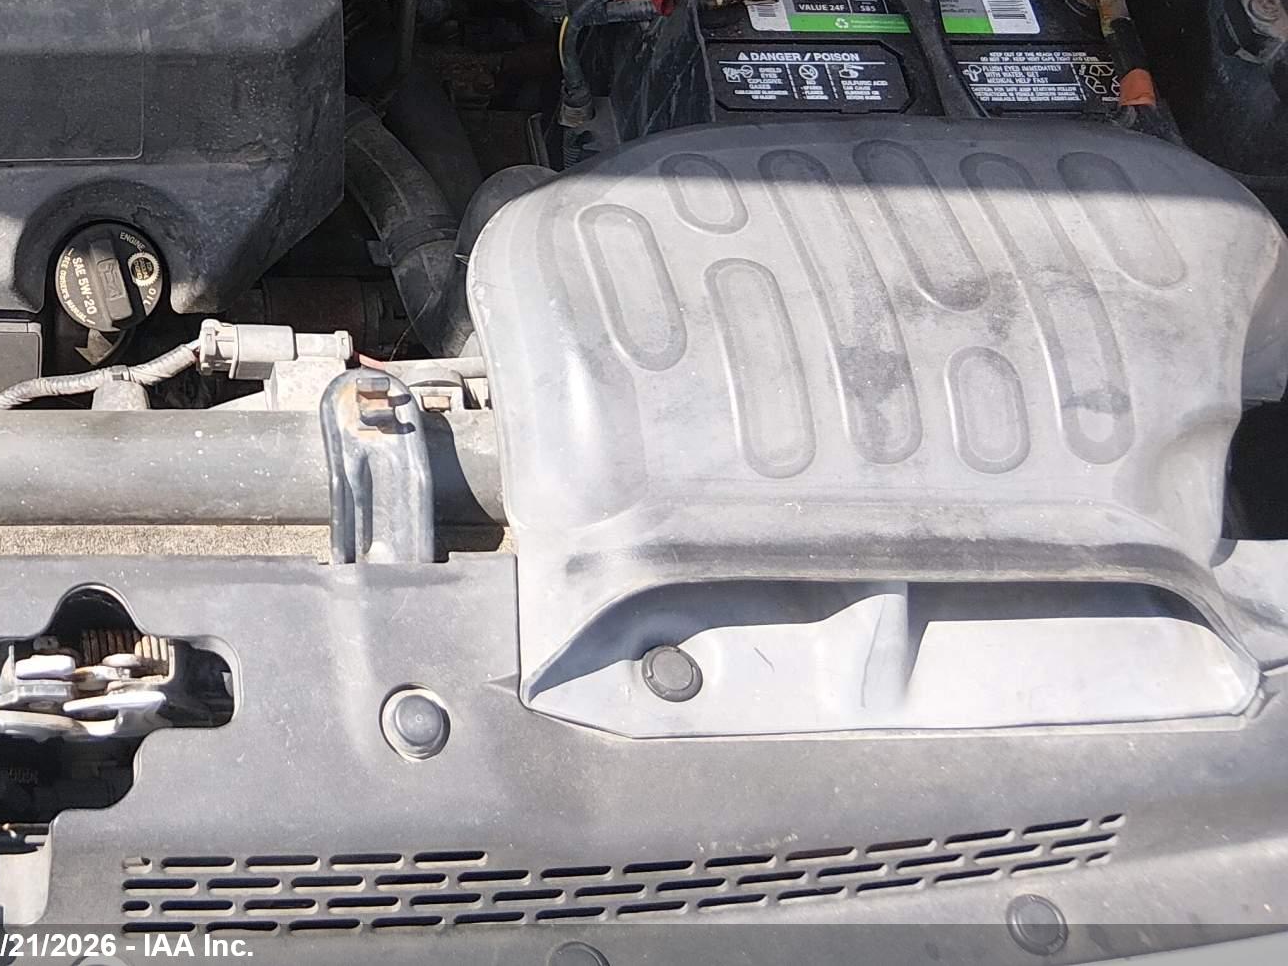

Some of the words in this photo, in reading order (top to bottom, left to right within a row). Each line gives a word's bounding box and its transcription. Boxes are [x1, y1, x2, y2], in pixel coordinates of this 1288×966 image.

[750, 52, 802, 61] DANGER
[813, 53, 860, 61] POISON
[119, 231, 146, 252] ENGINE
[72, 257, 87, 278] SAE
[78, 277, 98, 315] 5W-20
[143, 287, 157, 306] OIL
